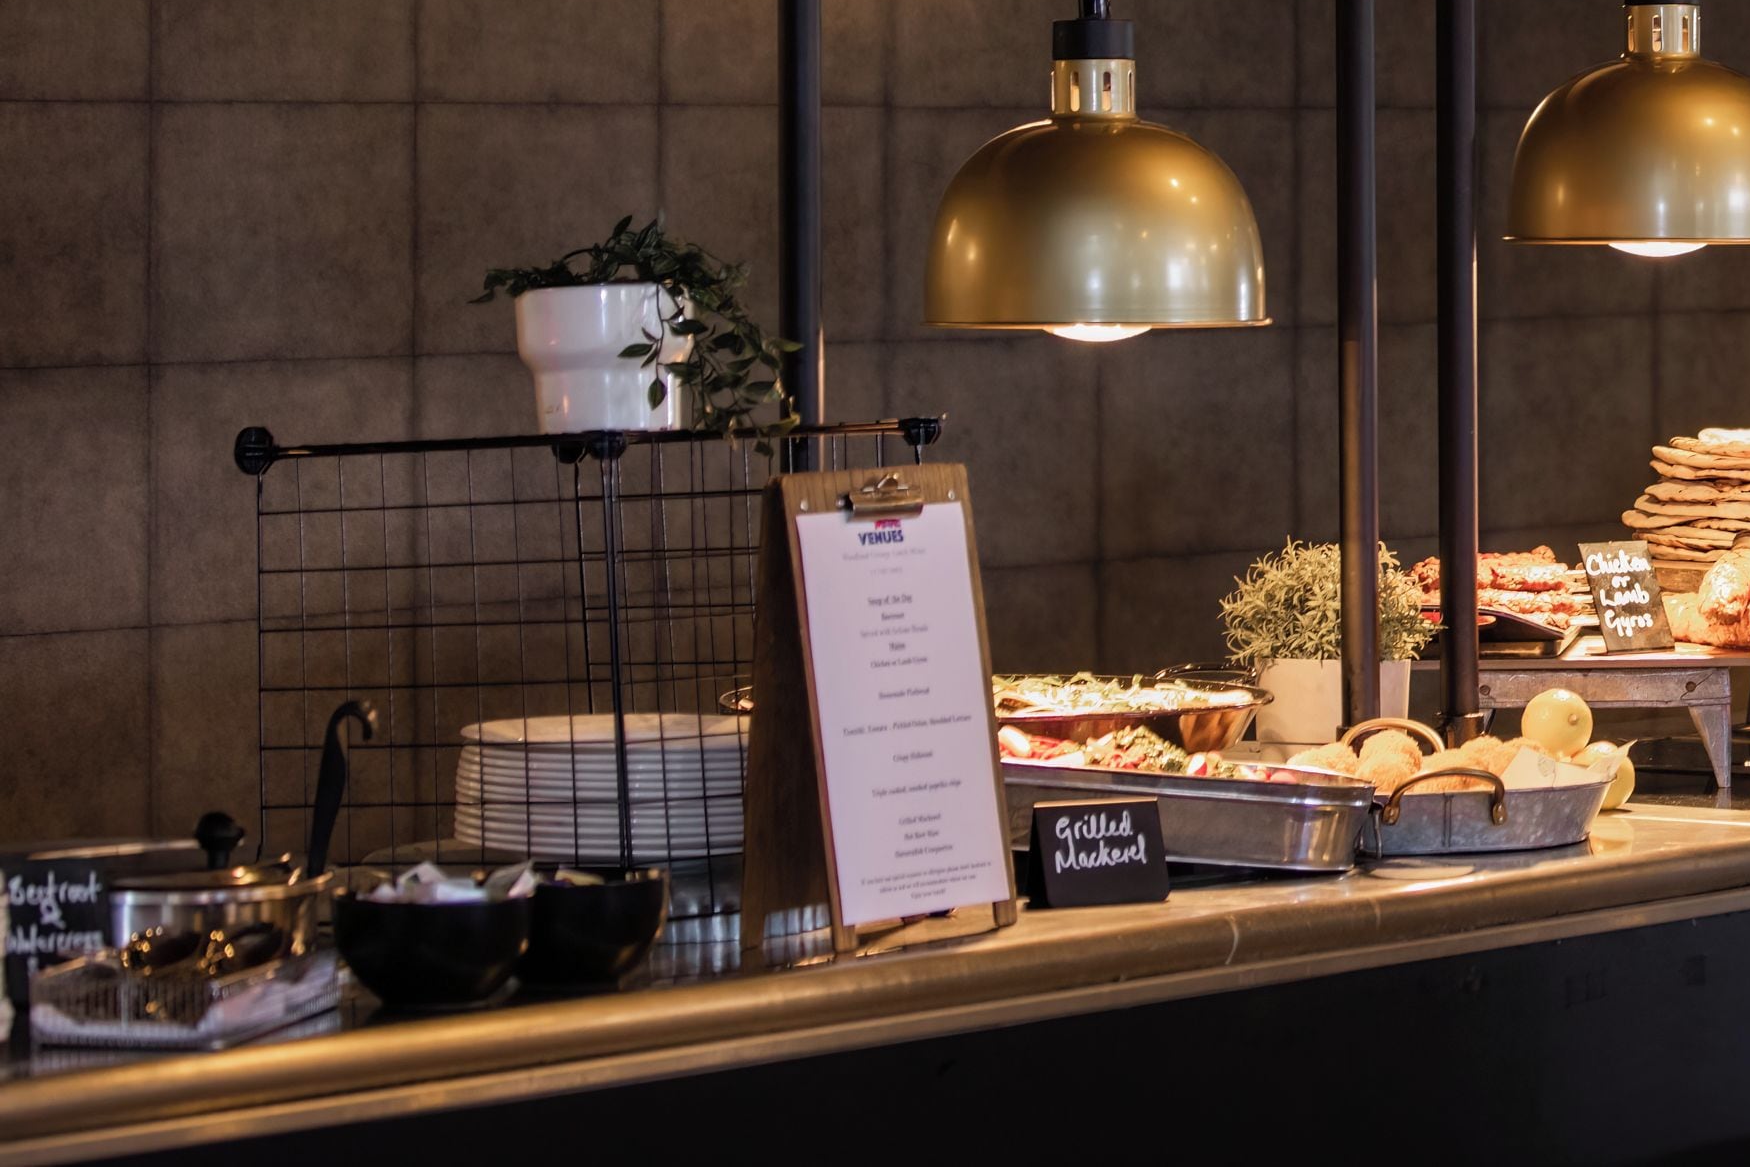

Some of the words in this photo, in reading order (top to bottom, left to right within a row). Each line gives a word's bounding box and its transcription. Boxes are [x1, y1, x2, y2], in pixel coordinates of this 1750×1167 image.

[858, 529, 904, 546] VENUES
[1586, 549, 1652, 576] Chicken
[1599, 582, 1650, 606] Lamb
[1611, 575, 1631, 588] or
[1604, 609, 1653, 637] Gyros
[1055, 810, 1134, 842] Grilled
[1055, 833, 1147, 874] Mackerel
